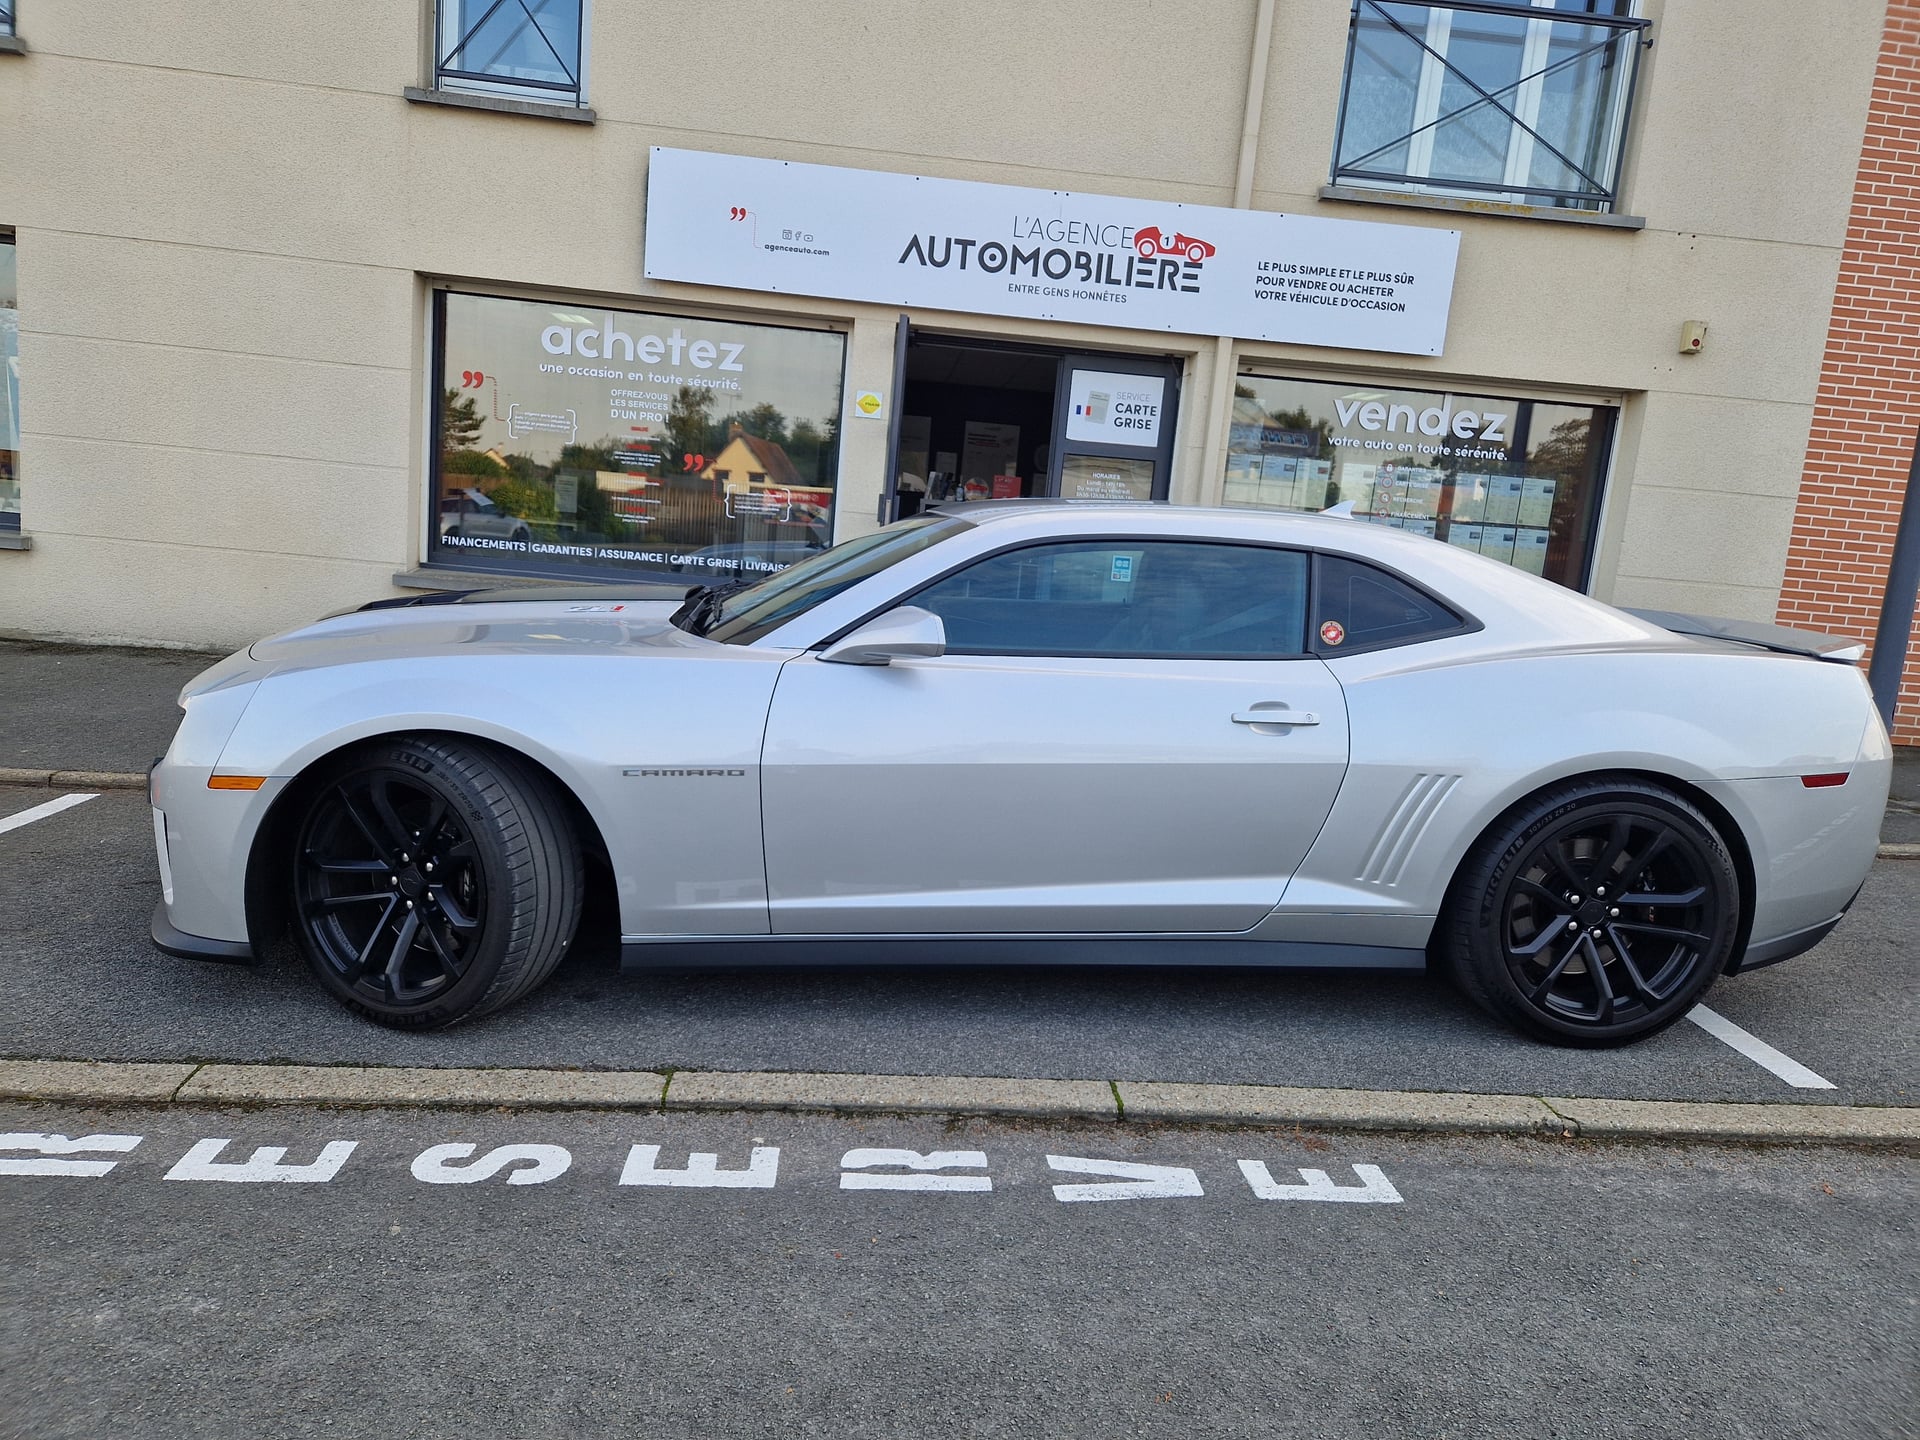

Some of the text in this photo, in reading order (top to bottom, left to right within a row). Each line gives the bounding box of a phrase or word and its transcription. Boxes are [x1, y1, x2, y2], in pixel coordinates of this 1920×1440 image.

[1013, 215, 1135, 249] L'AGENCE
[764, 244, 830, 256] agenceauto.com
[1258, 261, 1415, 285] LE PLUS SIMPLE ET LE PLUS SÛR
[1008, 283, 1127, 304] ENTRE GENS HONNÊTES
[1256, 275, 1394, 297] POUR VENDRE OU ACHETER
[1254, 289, 1406, 312] VOTRE VÉHICULE D'OCCASION
[540, 311, 745, 372] achetez
[539, 362, 741, 391] une occasion en toute sécurité.
[610, 389, 669, 401] OFFREZ-VOUS
[610, 398, 669, 411] LES SERVICES
[1116, 391, 1151, 402] SERVICE
[610, 409, 637, 421] D'UN
[639, 411, 664, 423] PRO
[1115, 402, 1157, 417] CARTE
[1334, 393, 1507, 442] vendez
[1113, 416, 1152, 430] GRISE
[1328, 437, 1508, 461] votre auto en toute sérénité.
[441, 535, 526, 551] FINANCEMENTS
[532, 543, 592, 557] GARANTIES
[600, 549, 663, 563] ASSURANCE
[670, 554, 704, 566] CARTE
[707, 557, 738, 569] GRISE
[622, 769, 745, 777] CAMARO
